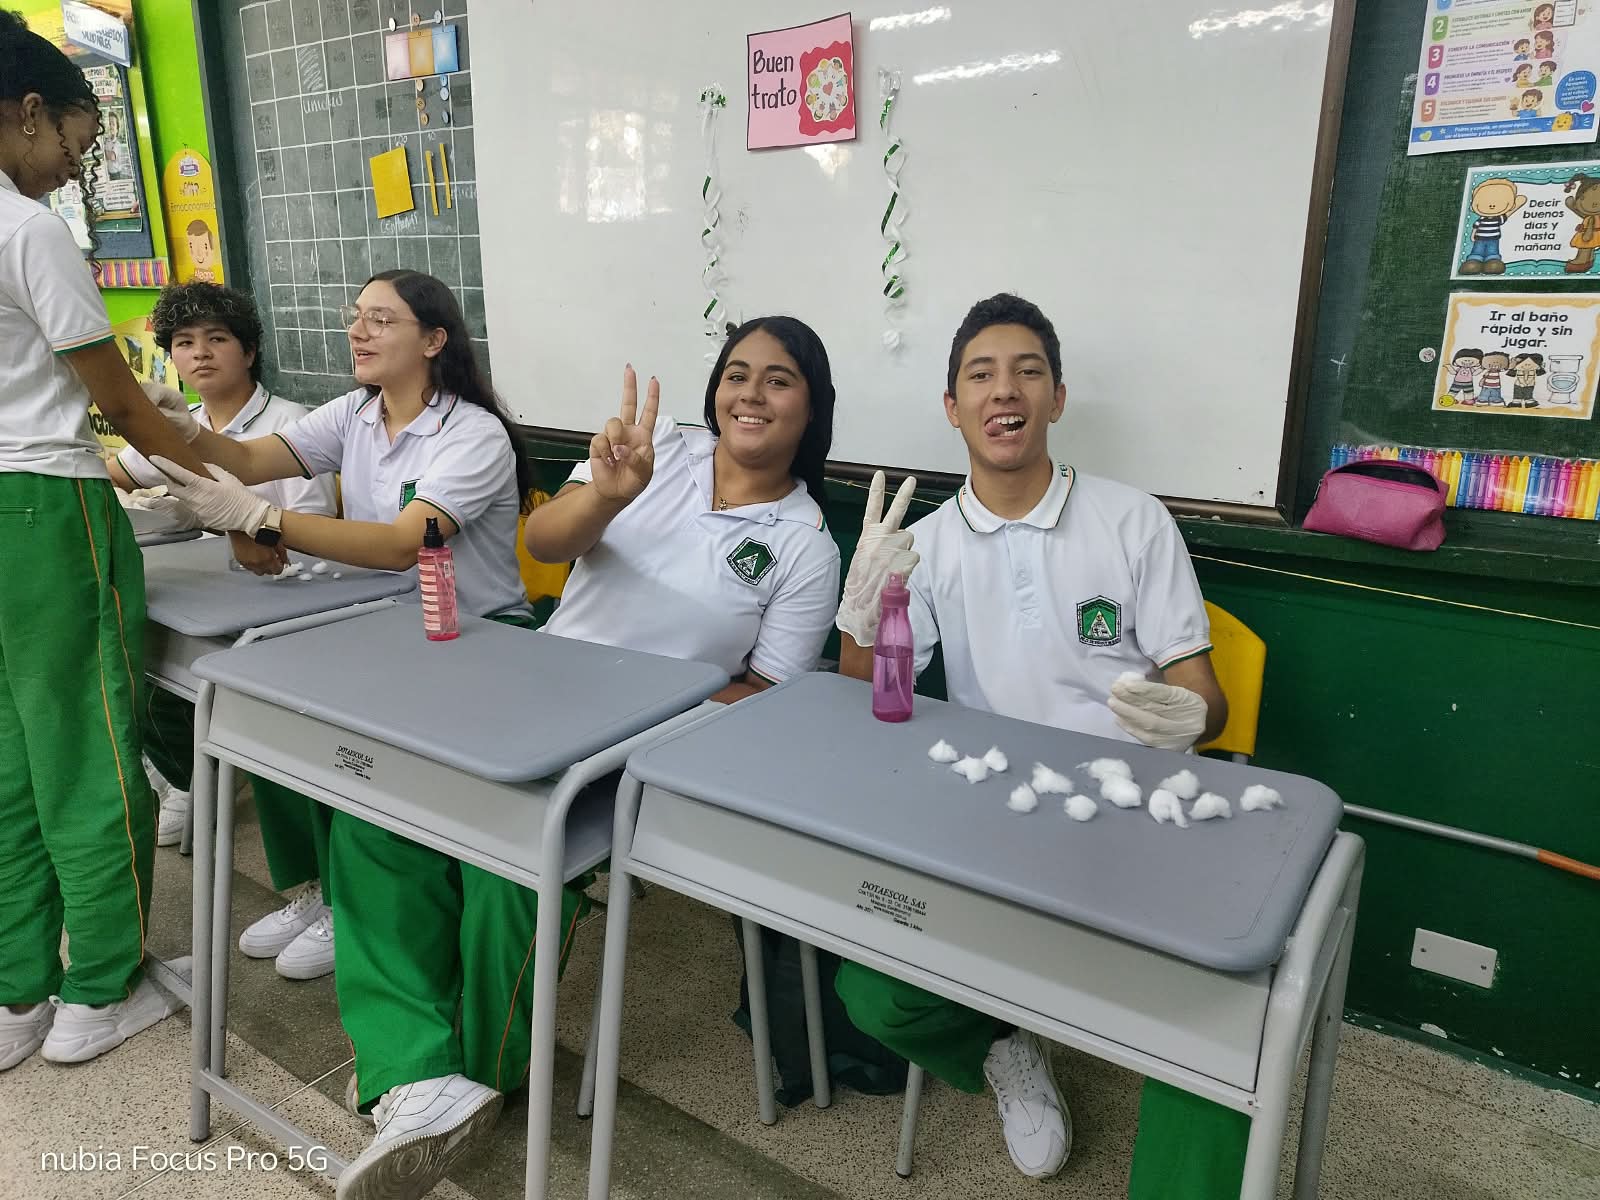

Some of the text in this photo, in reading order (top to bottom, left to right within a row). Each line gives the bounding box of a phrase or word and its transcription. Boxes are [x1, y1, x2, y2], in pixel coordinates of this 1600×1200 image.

[1435, 19, 1445, 33] 2
[1431, 48, 1440, 62] 3
[753, 49, 794, 75] Buen
[1427, 75, 1437, 89] 4
[751, 77, 797, 110] trato
[1423, 102, 1433, 115] 5
[1529, 198, 1561, 208] Decir
[1522, 210, 1565, 219] buenos
[1551, 221, 1559, 231] y
[1523, 231, 1556, 241] hasta
[1514, 242, 1562, 252] mañana
[1489, 310, 1568, 323] Ir al baño
[1480, 323, 1573, 337] rápido y sin
[1501, 336, 1548, 349] jugar.
[861, 880, 910, 904] DOTAESCOL
[910, 898, 927, 910] SAS
